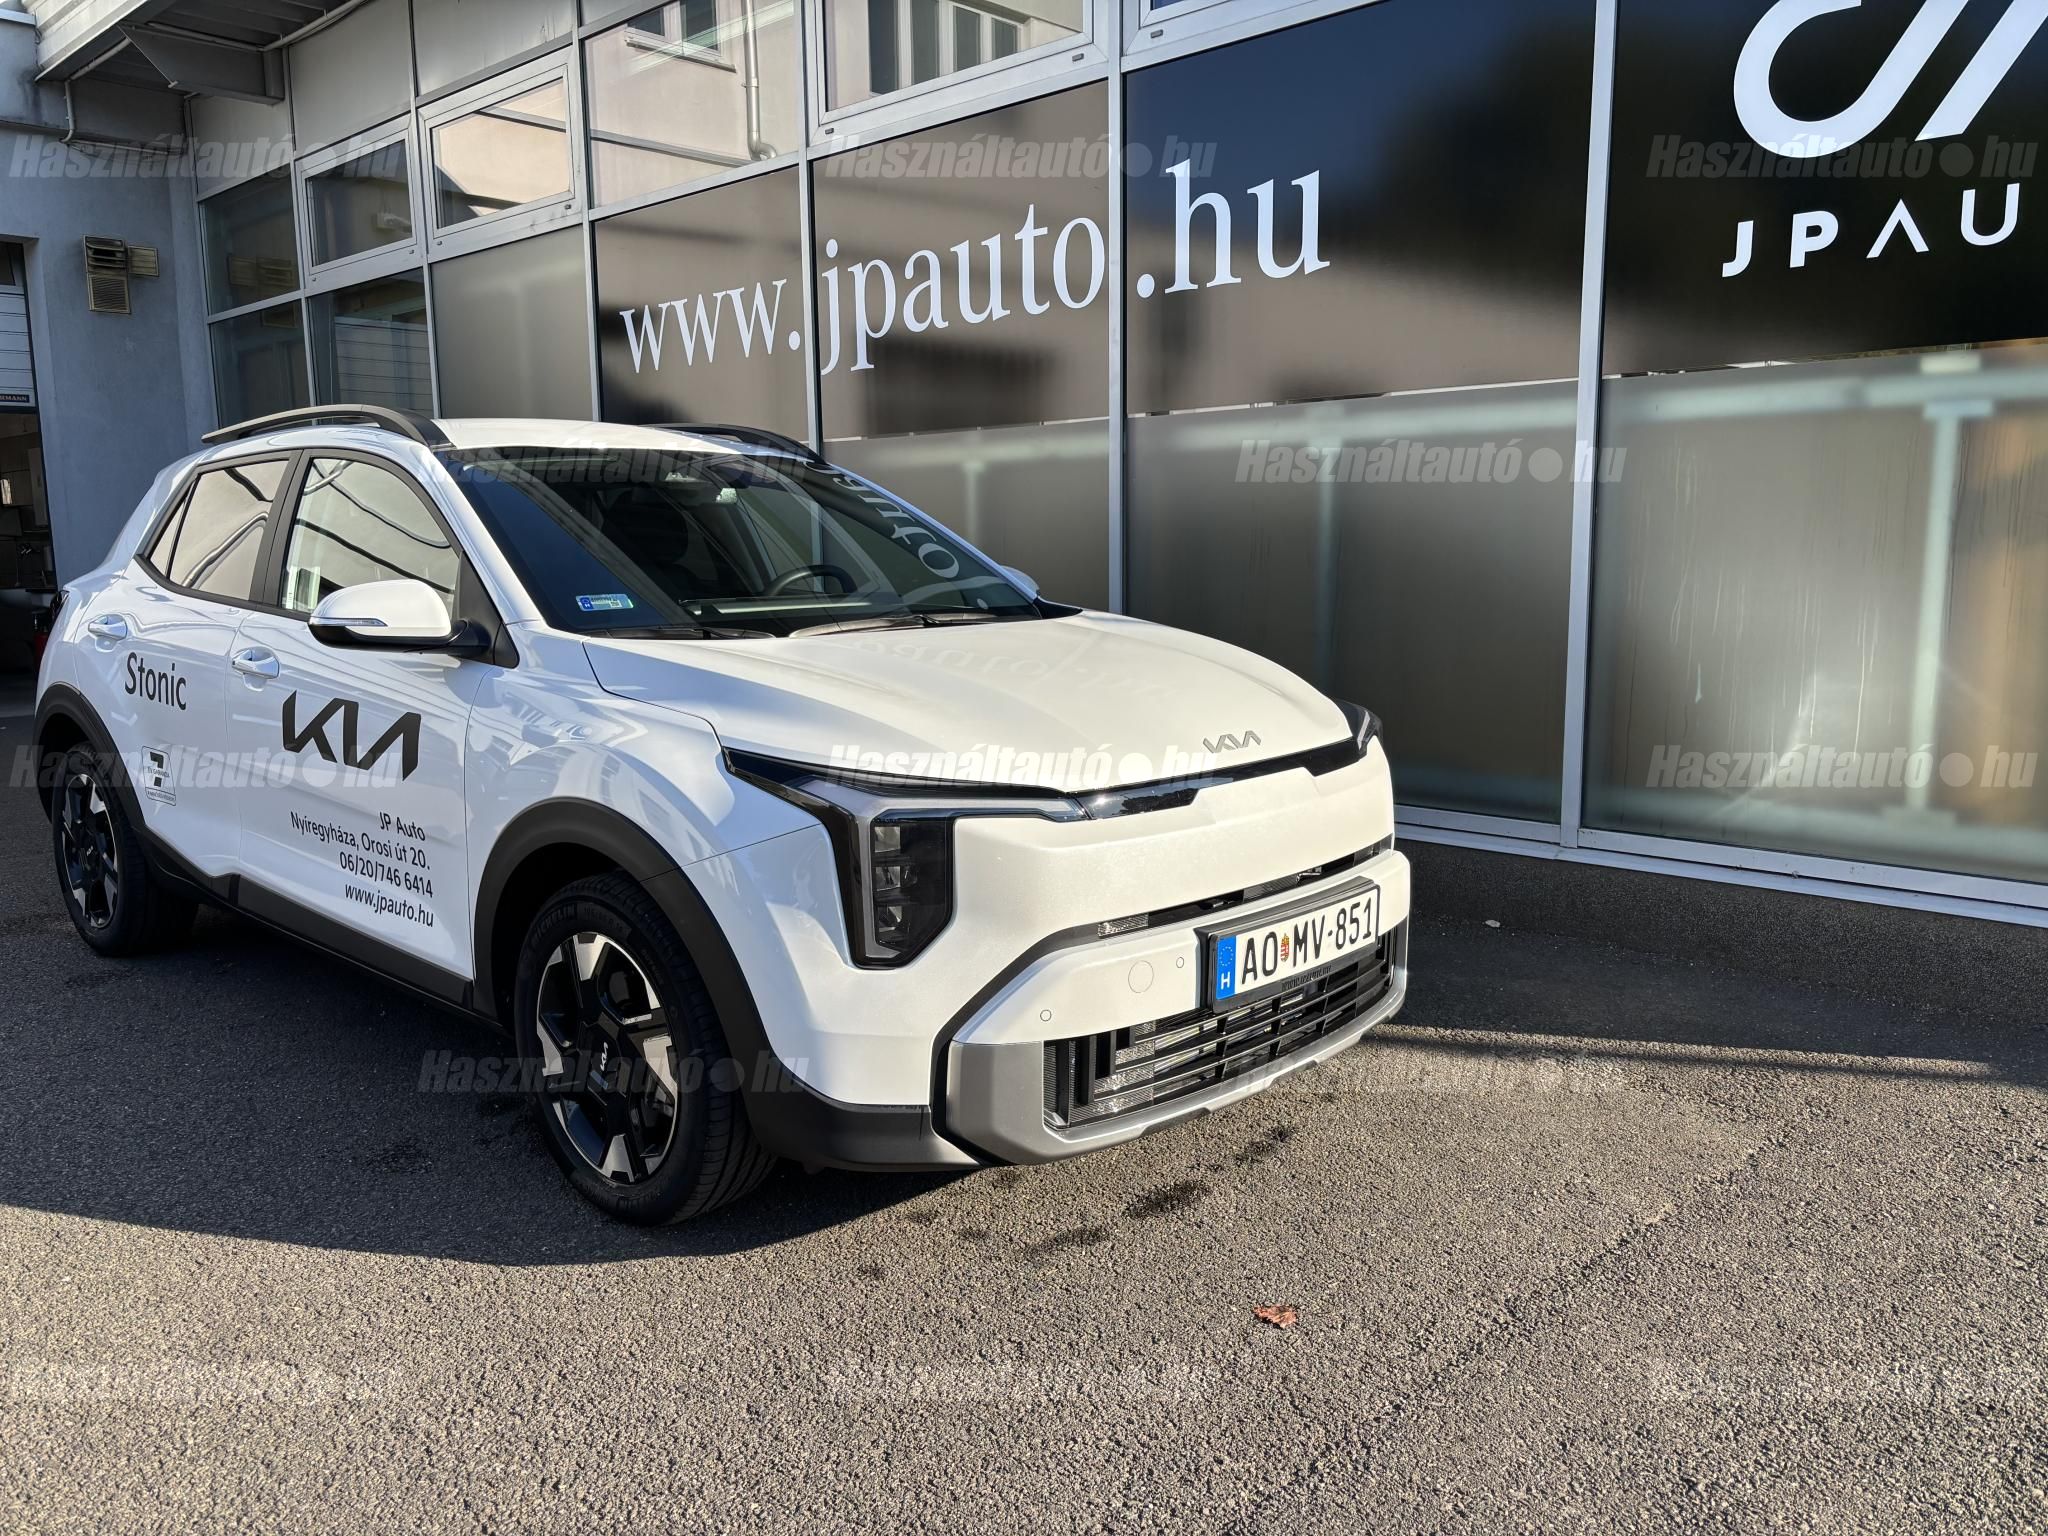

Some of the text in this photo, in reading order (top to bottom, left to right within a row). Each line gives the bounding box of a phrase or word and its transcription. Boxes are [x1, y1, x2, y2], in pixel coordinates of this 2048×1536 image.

[125, 652, 187, 710] Stonic
[282, 690, 421, 781] KIA
[1203, 730, 1261, 753] KIA
[379, 811, 426, 842] JP Auto
[361, 832, 393, 859] Orosi
[395, 842, 408, 863] út
[411, 846, 431, 871] 20.
[339, 851, 434, 899] 06/20/746 6414
[345, 883, 434, 928] www.jpauto.hu
[1221, 972, 1231, 990] H
